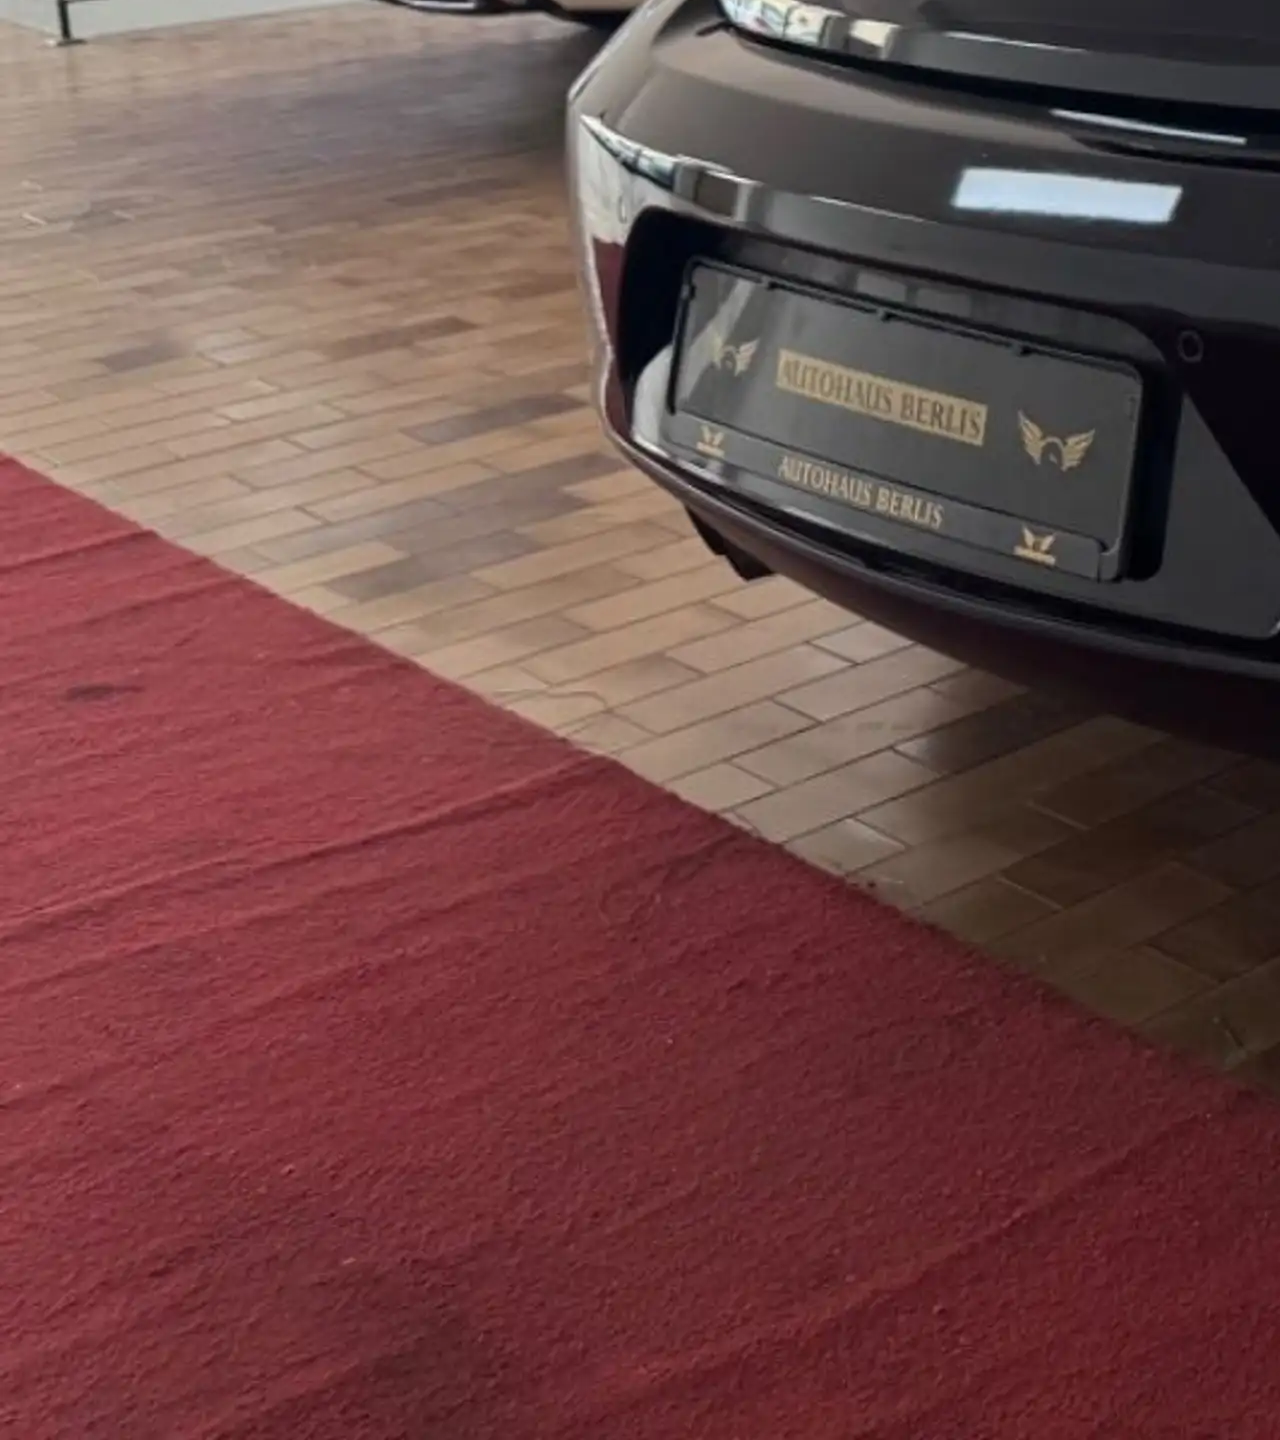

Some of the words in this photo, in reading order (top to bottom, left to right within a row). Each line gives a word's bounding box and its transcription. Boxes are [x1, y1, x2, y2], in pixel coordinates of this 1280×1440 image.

[782, 360, 894, 413] AUTOHAUS
[900, 392, 981, 438] BERLIS
[779, 456, 872, 506] AUTOHAUS
[876, 487, 944, 529] BERLIS
